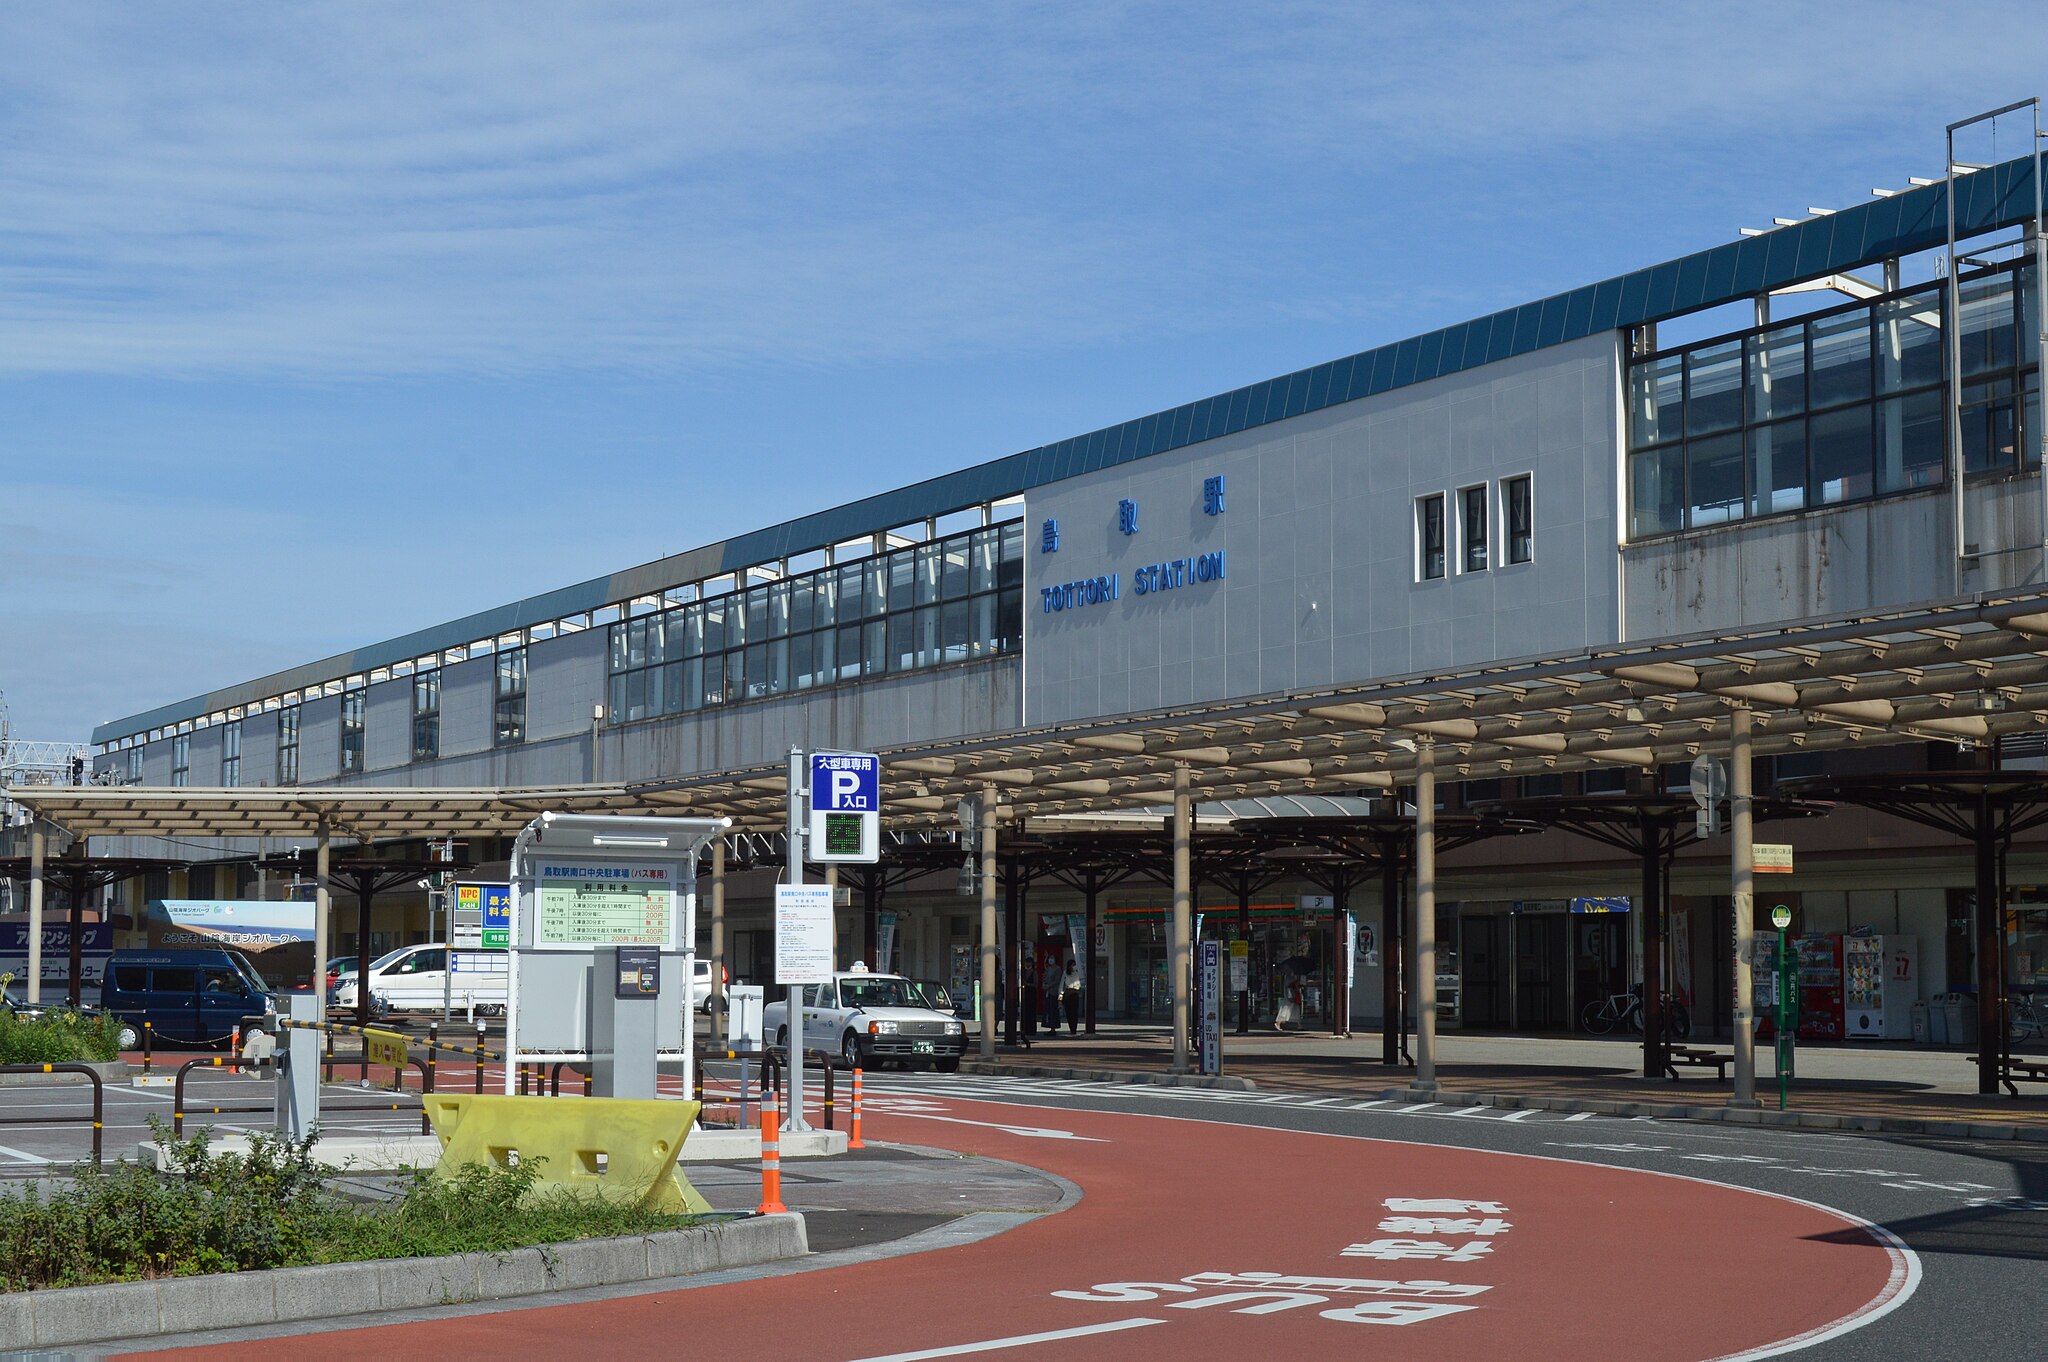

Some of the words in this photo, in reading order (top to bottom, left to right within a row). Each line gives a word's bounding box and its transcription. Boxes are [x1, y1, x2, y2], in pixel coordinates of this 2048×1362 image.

[1041, 573, 1119, 613] TOTTORI
[1134, 551, 1225, 595] STATION
[819, 757, 872, 771] 大型車専用
[831, 770, 861, 809] P
[843, 796, 867, 808] 入口
[826, 815, 861, 854] 空
[460, 889, 478, 899] NPC
[161, 933, 198, 944] ようこそ
[1206, 1033, 1217, 1041] TAXI
[1050, 1282, 1480, 1325] BUS
